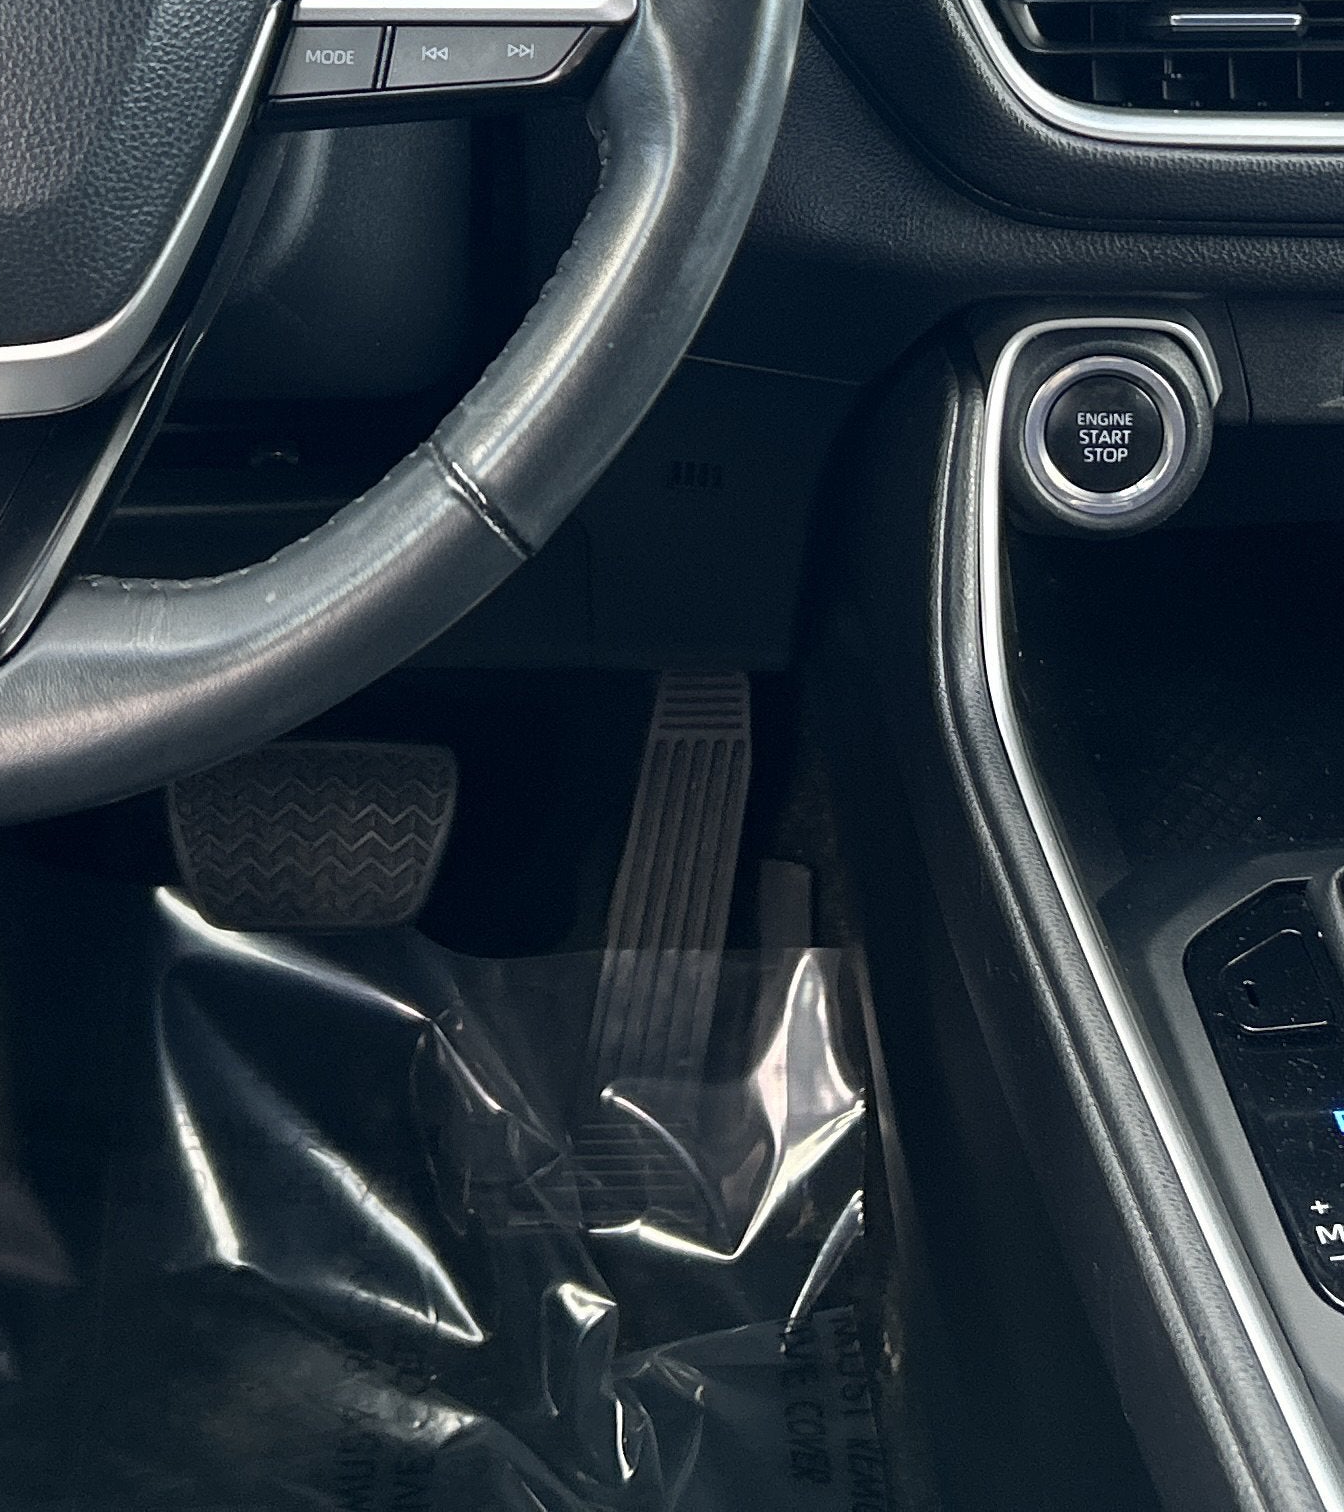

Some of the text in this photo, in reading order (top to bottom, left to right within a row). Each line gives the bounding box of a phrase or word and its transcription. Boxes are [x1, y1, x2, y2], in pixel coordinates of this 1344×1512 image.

[305, 49, 356, 66] MODE
[1076, 412, 1135, 426] ENGINE
[1078, 429, 1133, 445] START
[1083, 447, 1129, 463] STOP
